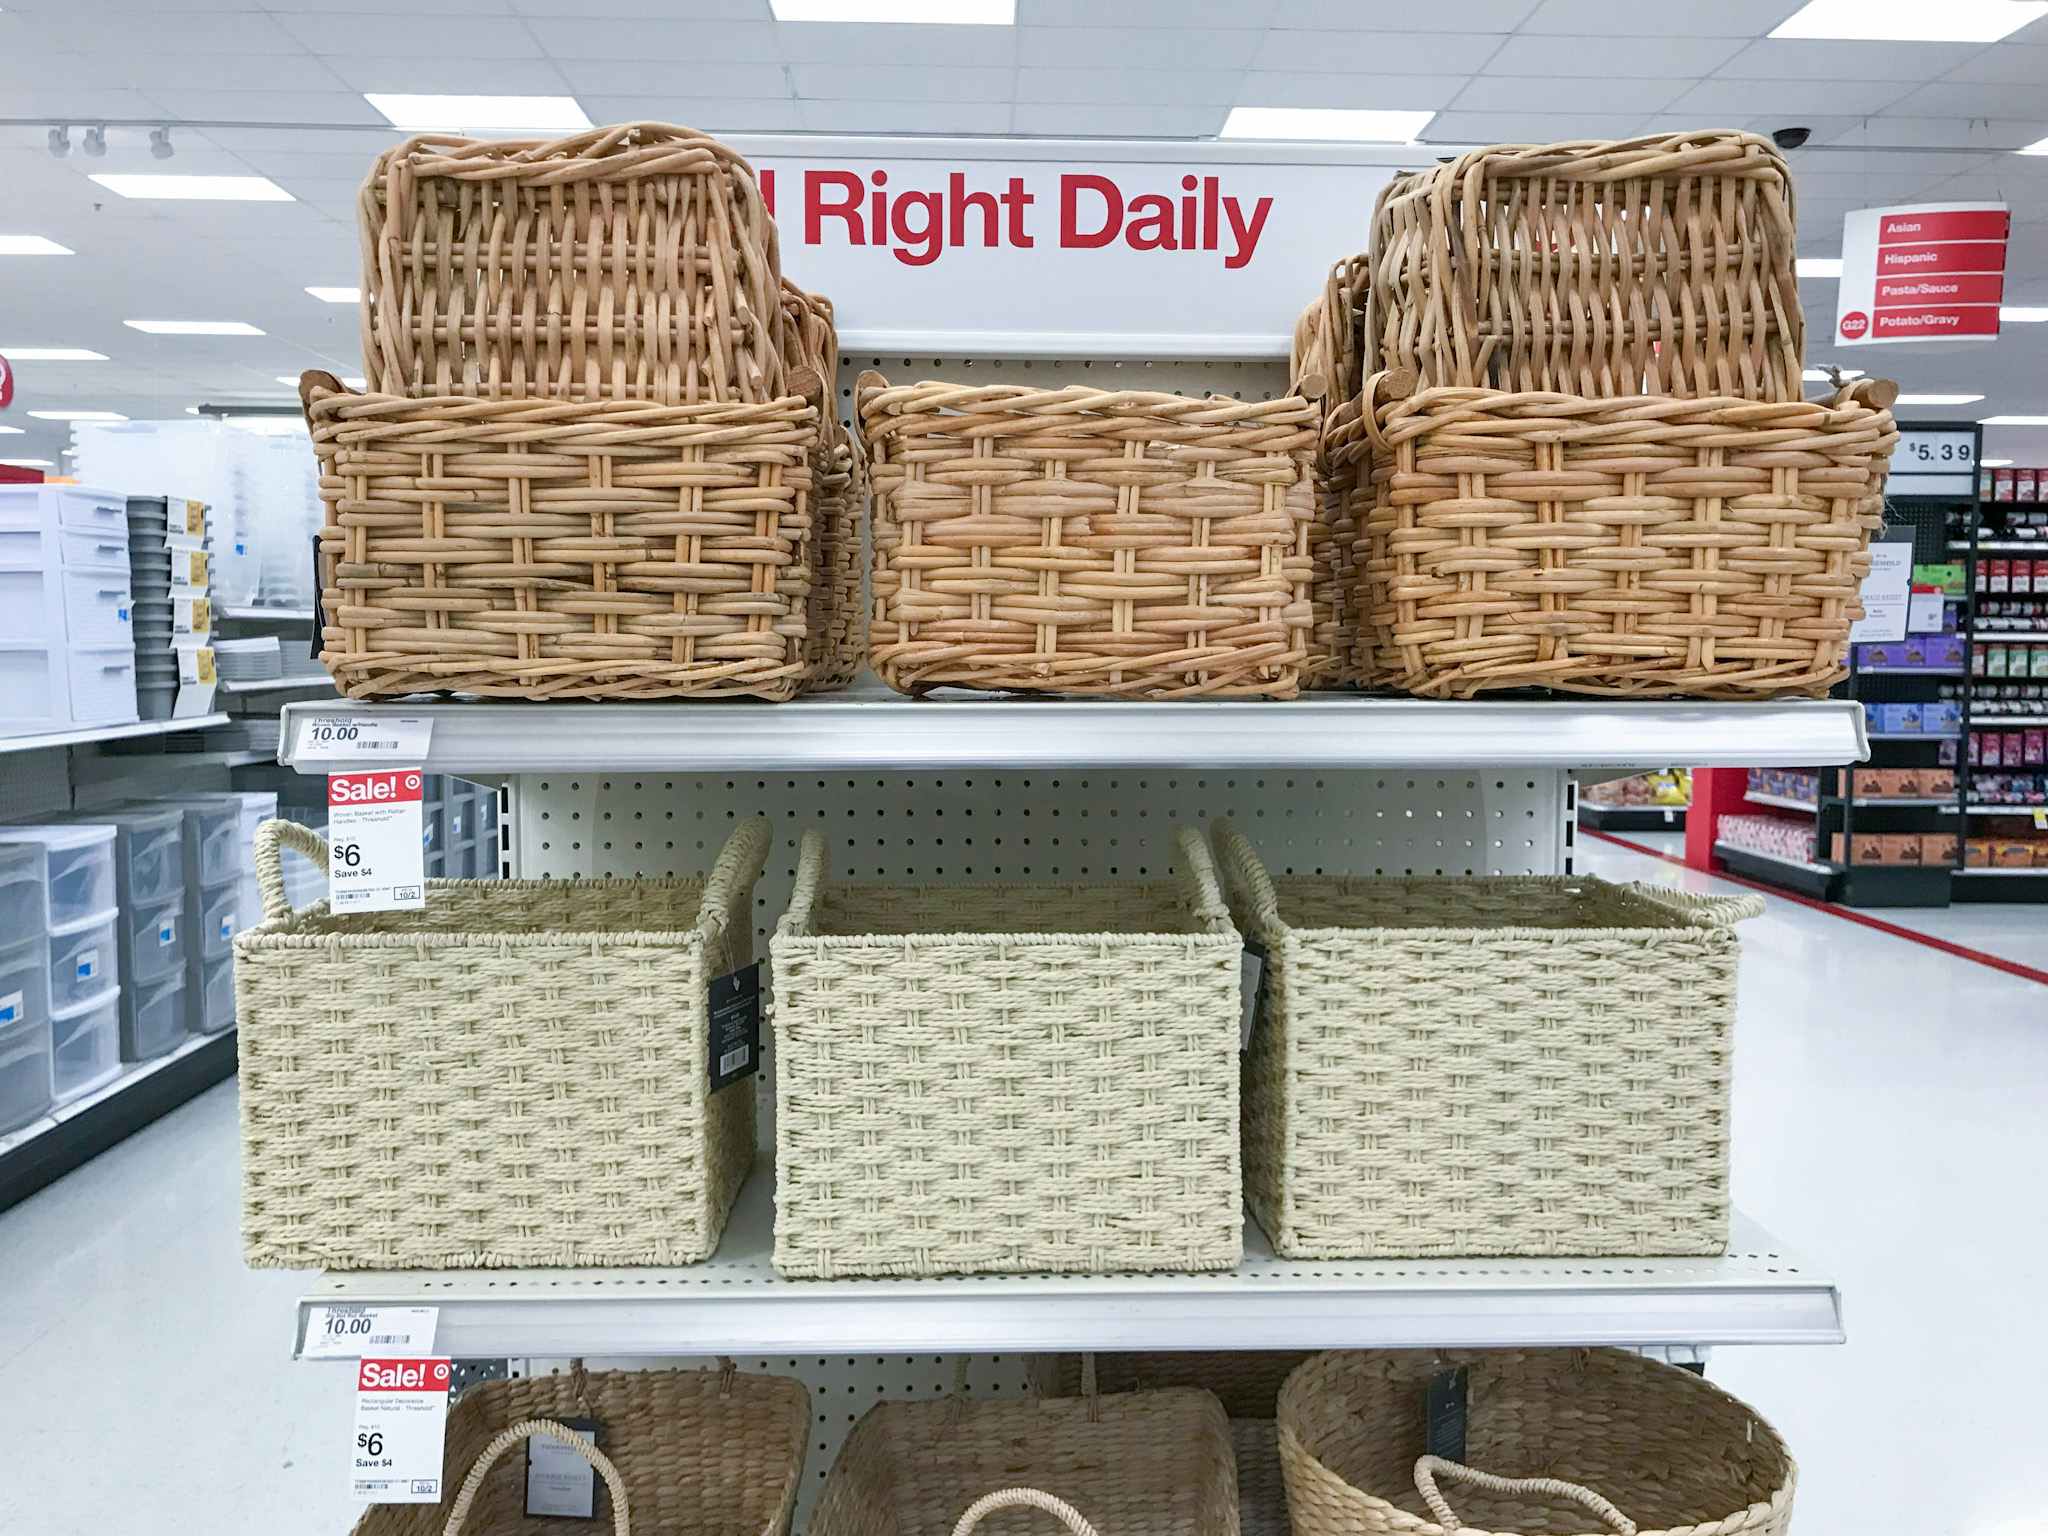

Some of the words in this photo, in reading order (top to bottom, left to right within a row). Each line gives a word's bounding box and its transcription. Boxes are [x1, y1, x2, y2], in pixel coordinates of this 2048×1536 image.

[804, 170, 1034, 266] Right
[1060, 174, 1274, 269] Daily
[1887, 222, 1921, 234] Asian
[1885, 251, 1938, 265] Hispanic
[1881, 282, 1959, 297] Pasta/Sauce
[1842, 319, 1867, 330] G22
[1879, 314, 1961, 328] Potato/Gravy
[311, 727, 359, 740] 10.00
[331, 775, 396, 802] Sale!
[334, 844, 361, 866] $6
[334, 869, 358, 878] Save
[361, 867, 373, 877] $4
[399, 891, 417, 899] 10/2
[325, 1318, 372, 1335] 10.00
[361, 1362, 425, 1387] Sale!
[357, 1433, 383, 1456] $6
[356, 1458, 379, 1467] Save
[382, 1459, 393, 1467] $4
